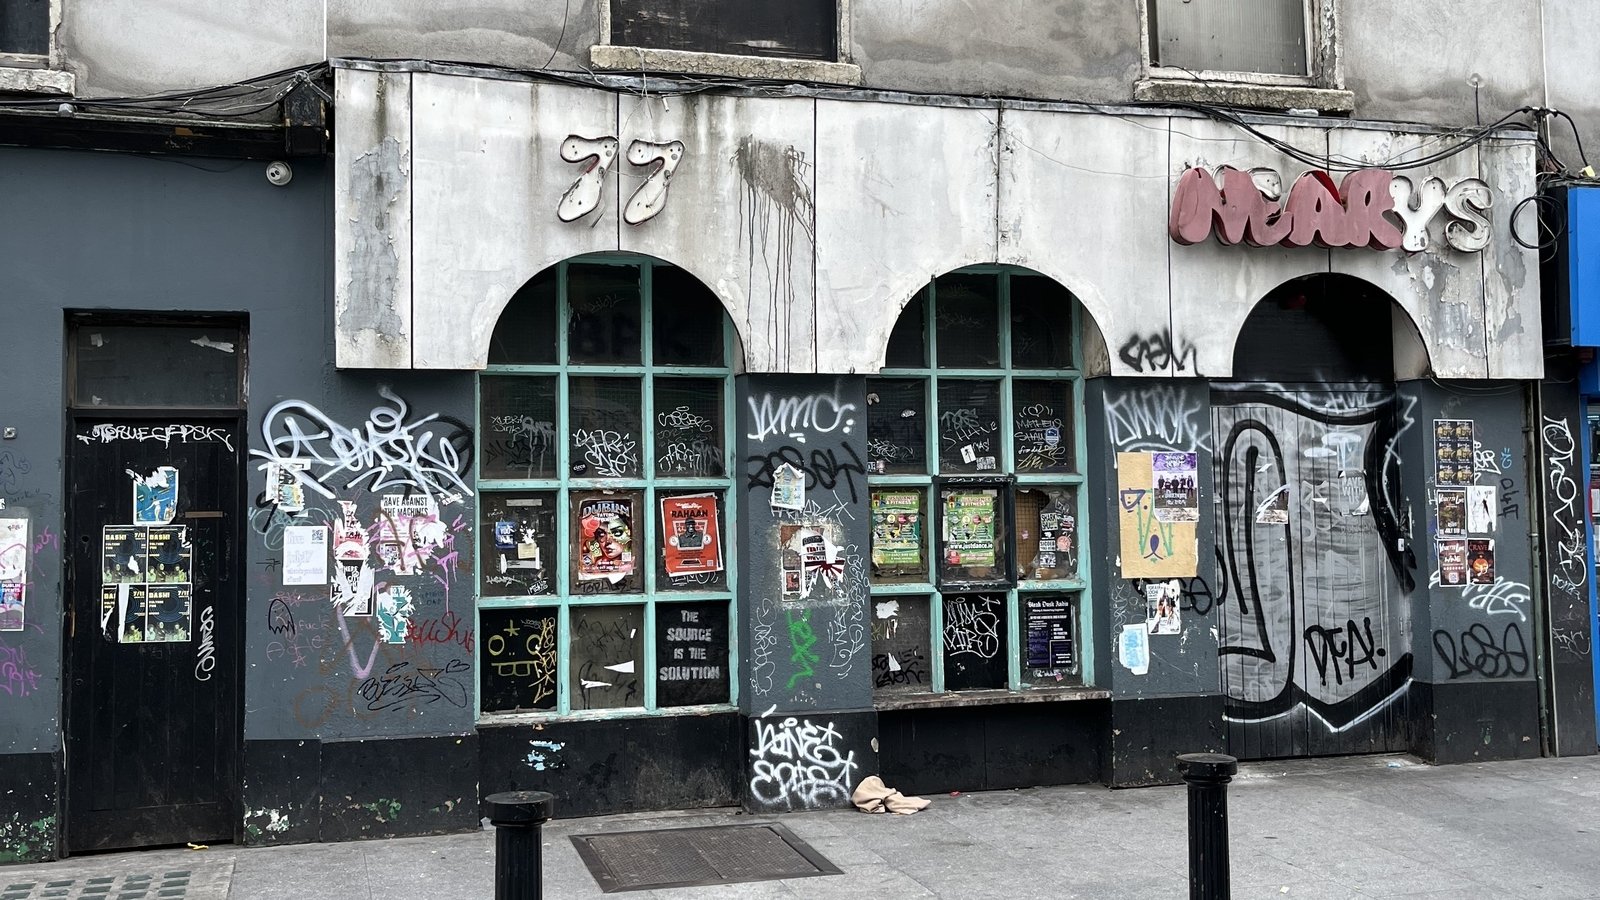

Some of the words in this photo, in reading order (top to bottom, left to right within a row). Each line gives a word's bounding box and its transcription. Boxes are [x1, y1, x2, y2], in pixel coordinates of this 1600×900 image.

[557, 134, 685, 226] 77
[401, 496, 428, 507] AGAINST
[671, 509, 708, 518] RAHAAN
[680, 609, 699, 623] THE
[666, 627, 712, 643] SOURCE
[673, 648, 684, 660] IS
[689, 647, 707, 660] THE
[659, 665, 721, 682] SOLUTION
